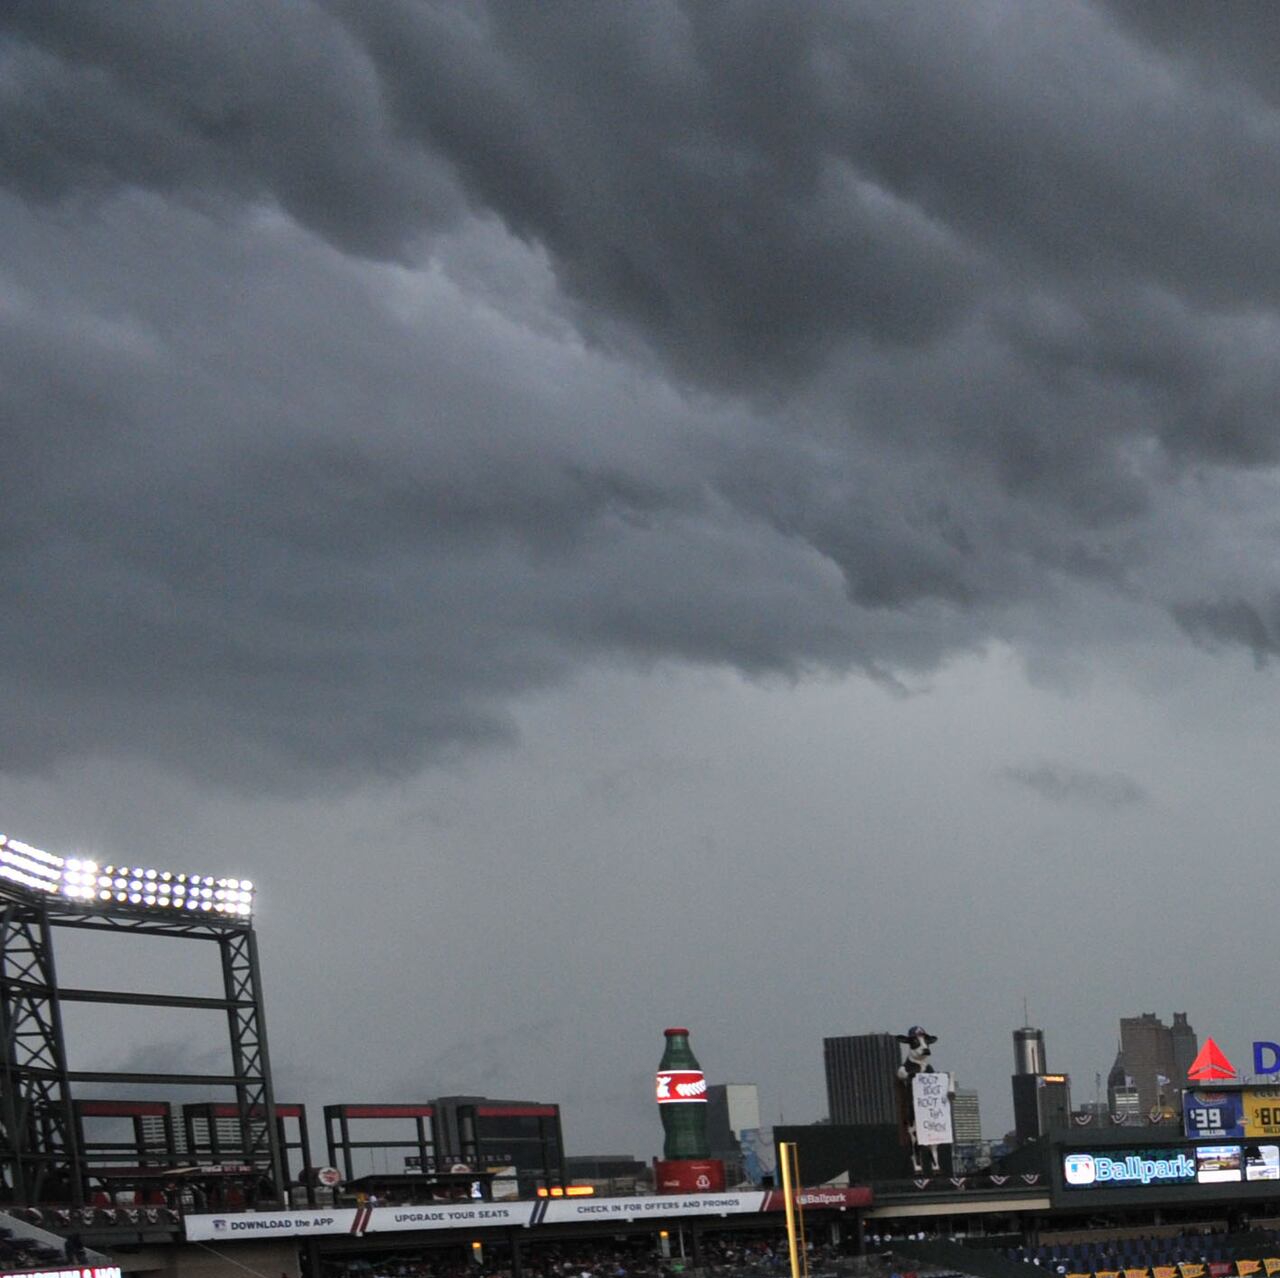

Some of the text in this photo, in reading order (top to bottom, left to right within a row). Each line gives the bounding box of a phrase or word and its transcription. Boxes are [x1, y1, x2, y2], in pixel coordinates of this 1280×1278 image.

[1095, 1154, 1195, 1183] Ballpark
[808, 1192, 846, 1205] Ballpark
[577, 1199, 740, 1214] CHECK IN FOR OFFERS AND PROMOS
[395, 1208, 510, 1223] UPGRADE YOUR SEATS
[231, 1217, 334, 1231] DOWNLOAD the APP
